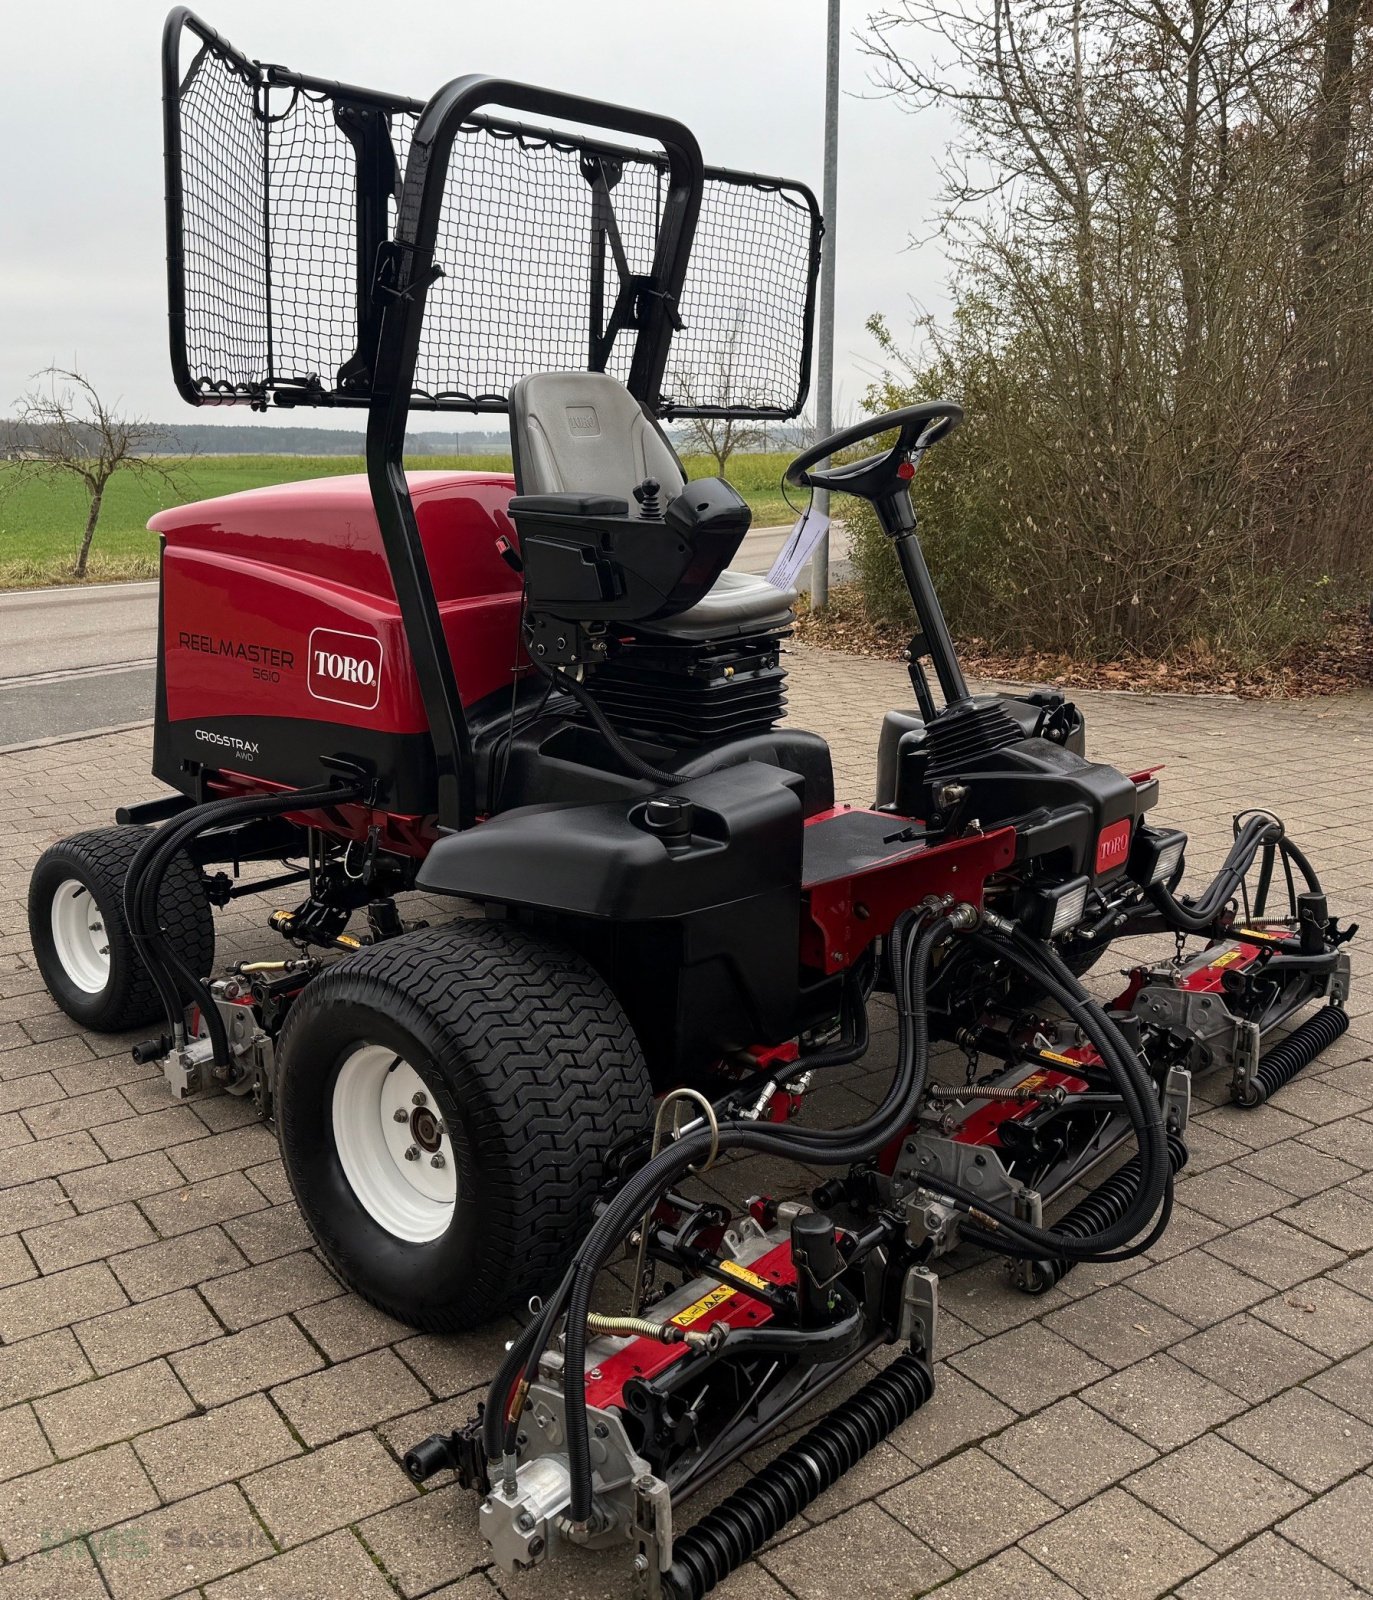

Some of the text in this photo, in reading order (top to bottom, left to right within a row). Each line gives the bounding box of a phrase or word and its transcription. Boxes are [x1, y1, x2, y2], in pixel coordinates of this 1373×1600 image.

[179, 631, 295, 670] REELMASTER
[252, 667, 281, 684] 5610
[195, 729, 260, 754] CROSSTRAX
[235, 750, 254, 762] AWD
[1100, 833, 1128, 859] TORO
